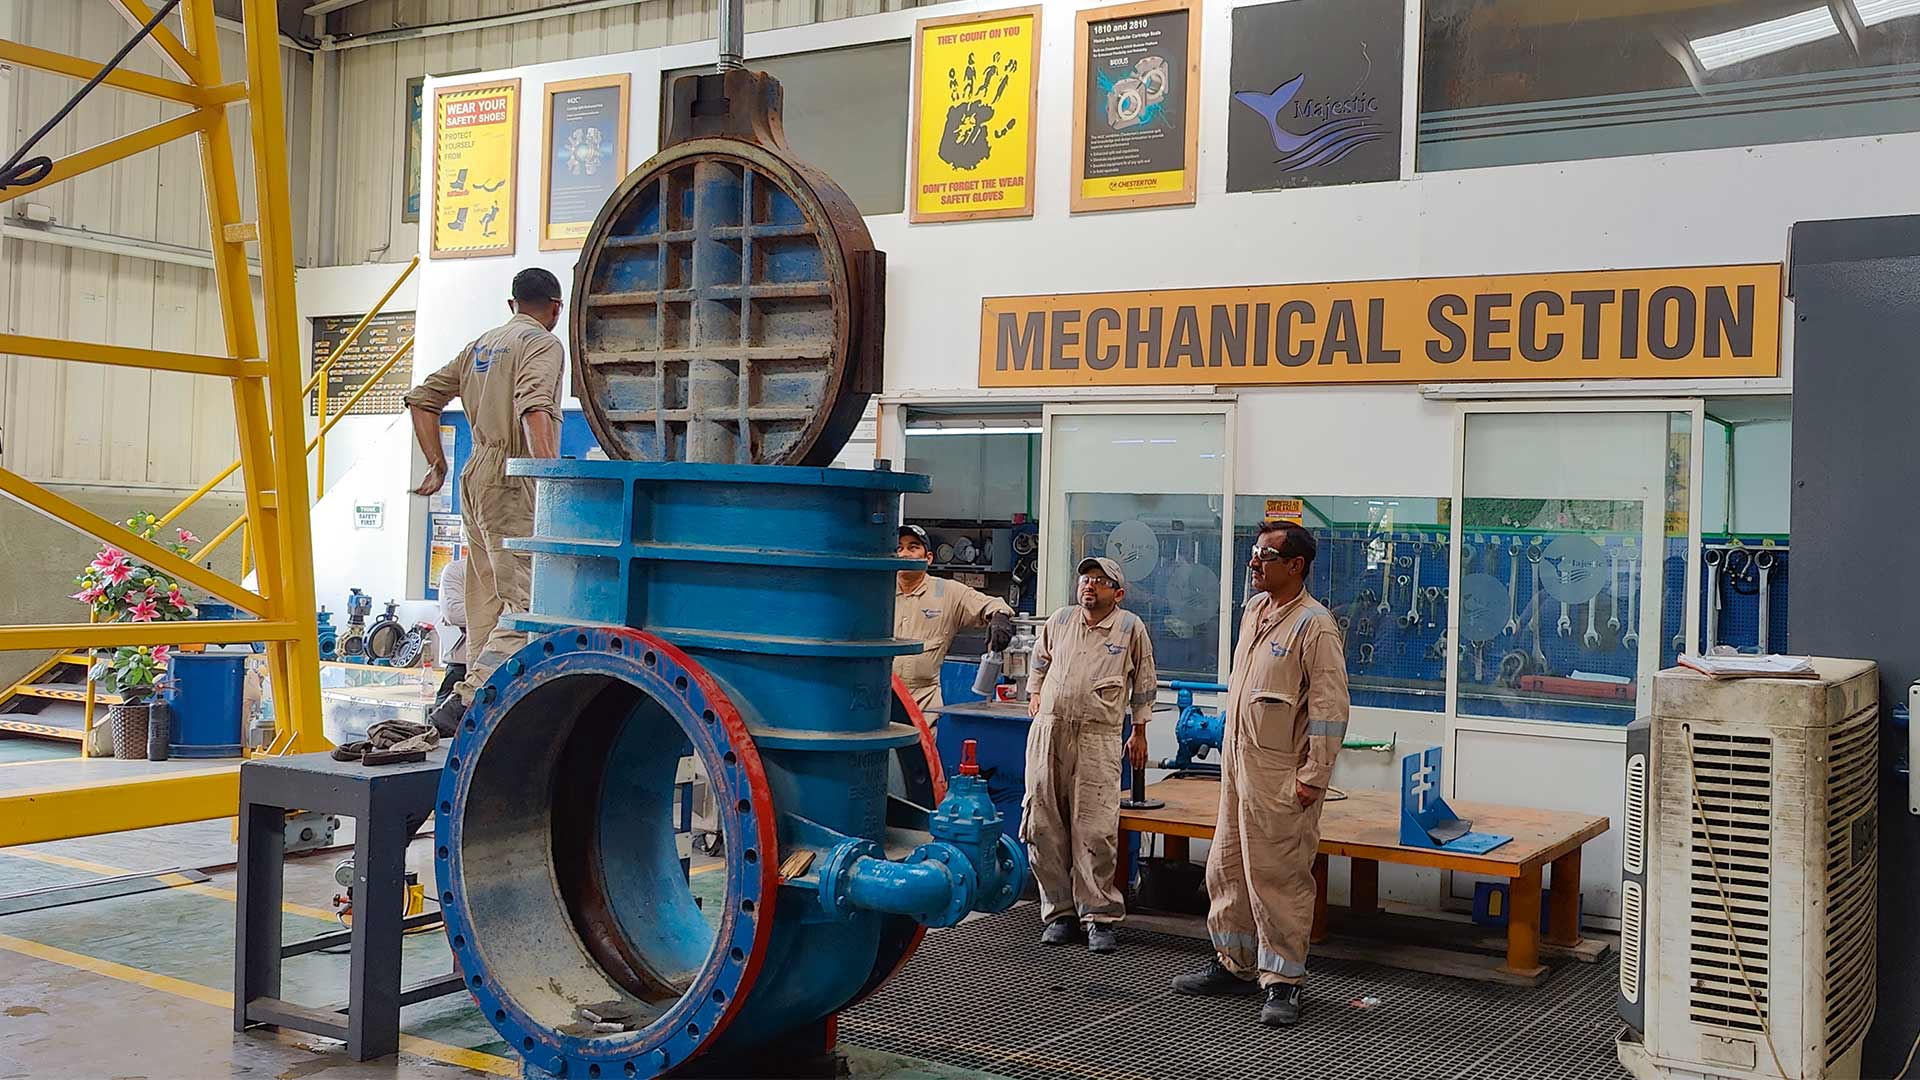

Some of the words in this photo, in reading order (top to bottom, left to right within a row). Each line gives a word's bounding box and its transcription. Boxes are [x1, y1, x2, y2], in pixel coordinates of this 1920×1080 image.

[1094, 24, 1112, 34] 1810
[1113, 21, 1128, 32] and
[1129, 19, 1148, 30] 2810
[937, 34, 958, 46] THEY
[960, 30, 987, 43] COUNT
[989, 28, 1001, 39] ON
[1003, 26, 1020, 37] YOU
[447, 102, 476, 115] WEAR
[478, 98, 506, 112] YOUR
[1293, 92, 1378, 121] Majestic
[446, 114, 477, 127] SAFETY
[478, 111, 506, 123] SHOES
[445, 131, 472, 140] PROTECT
[445, 140, 475, 150] YOURSELF
[923, 183, 947, 194] DON'T
[949, 180, 979, 192] FORGET
[981, 178, 997, 189] THE
[998, 176, 1024, 188] WEAR
[1118, 178, 1158, 188] CHESTERTON
[940, 193, 970, 205] SAFETY
[972, 190, 1004, 202] GLOVES
[996, 297, 1401, 371] MECHANICAL
[1425, 284, 1756, 365] SECTION
